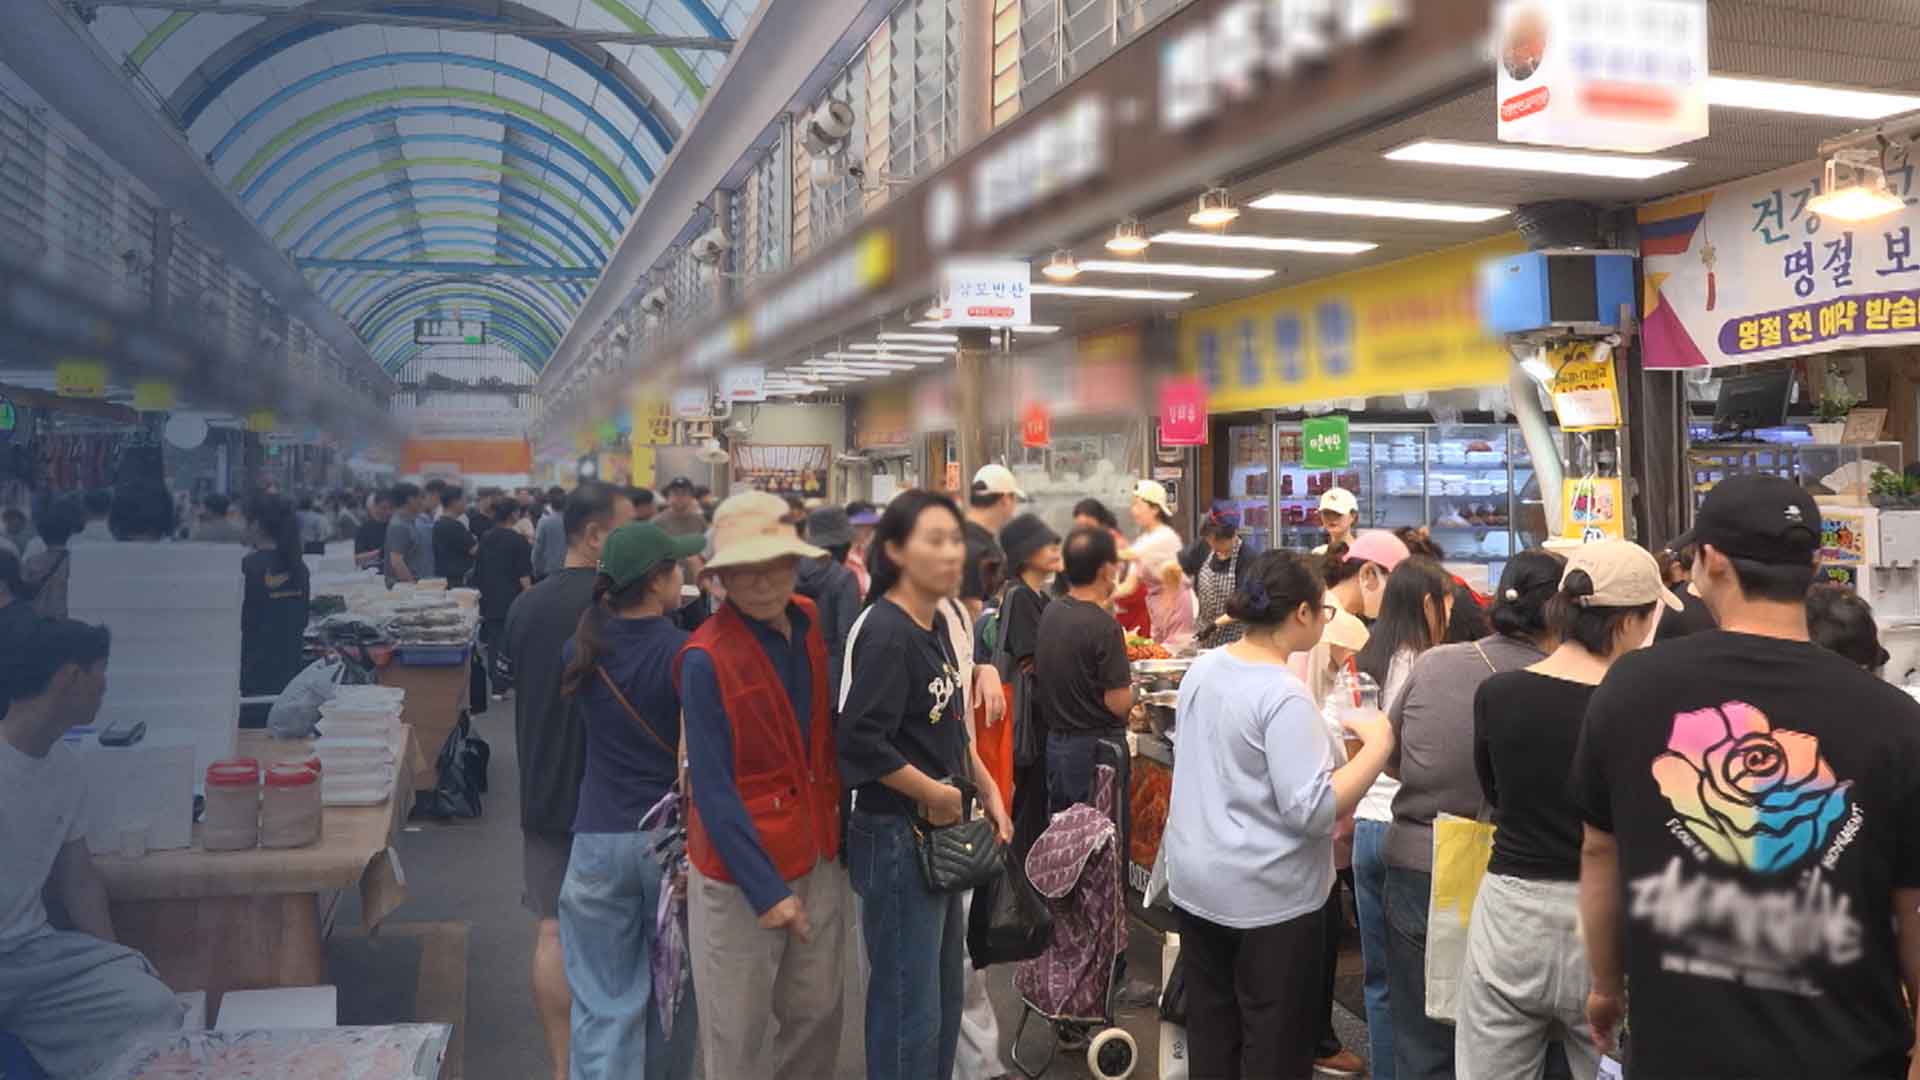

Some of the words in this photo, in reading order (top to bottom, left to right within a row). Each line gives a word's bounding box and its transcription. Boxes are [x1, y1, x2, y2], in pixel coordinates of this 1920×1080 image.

[1784, 231, 1853, 298] 명절
[1738, 316, 1782, 350] 명절
[1788, 311, 1813, 342] 전
[1819, 301, 1859, 336] 예약
[1866, 296, 1920, 330] 받습
